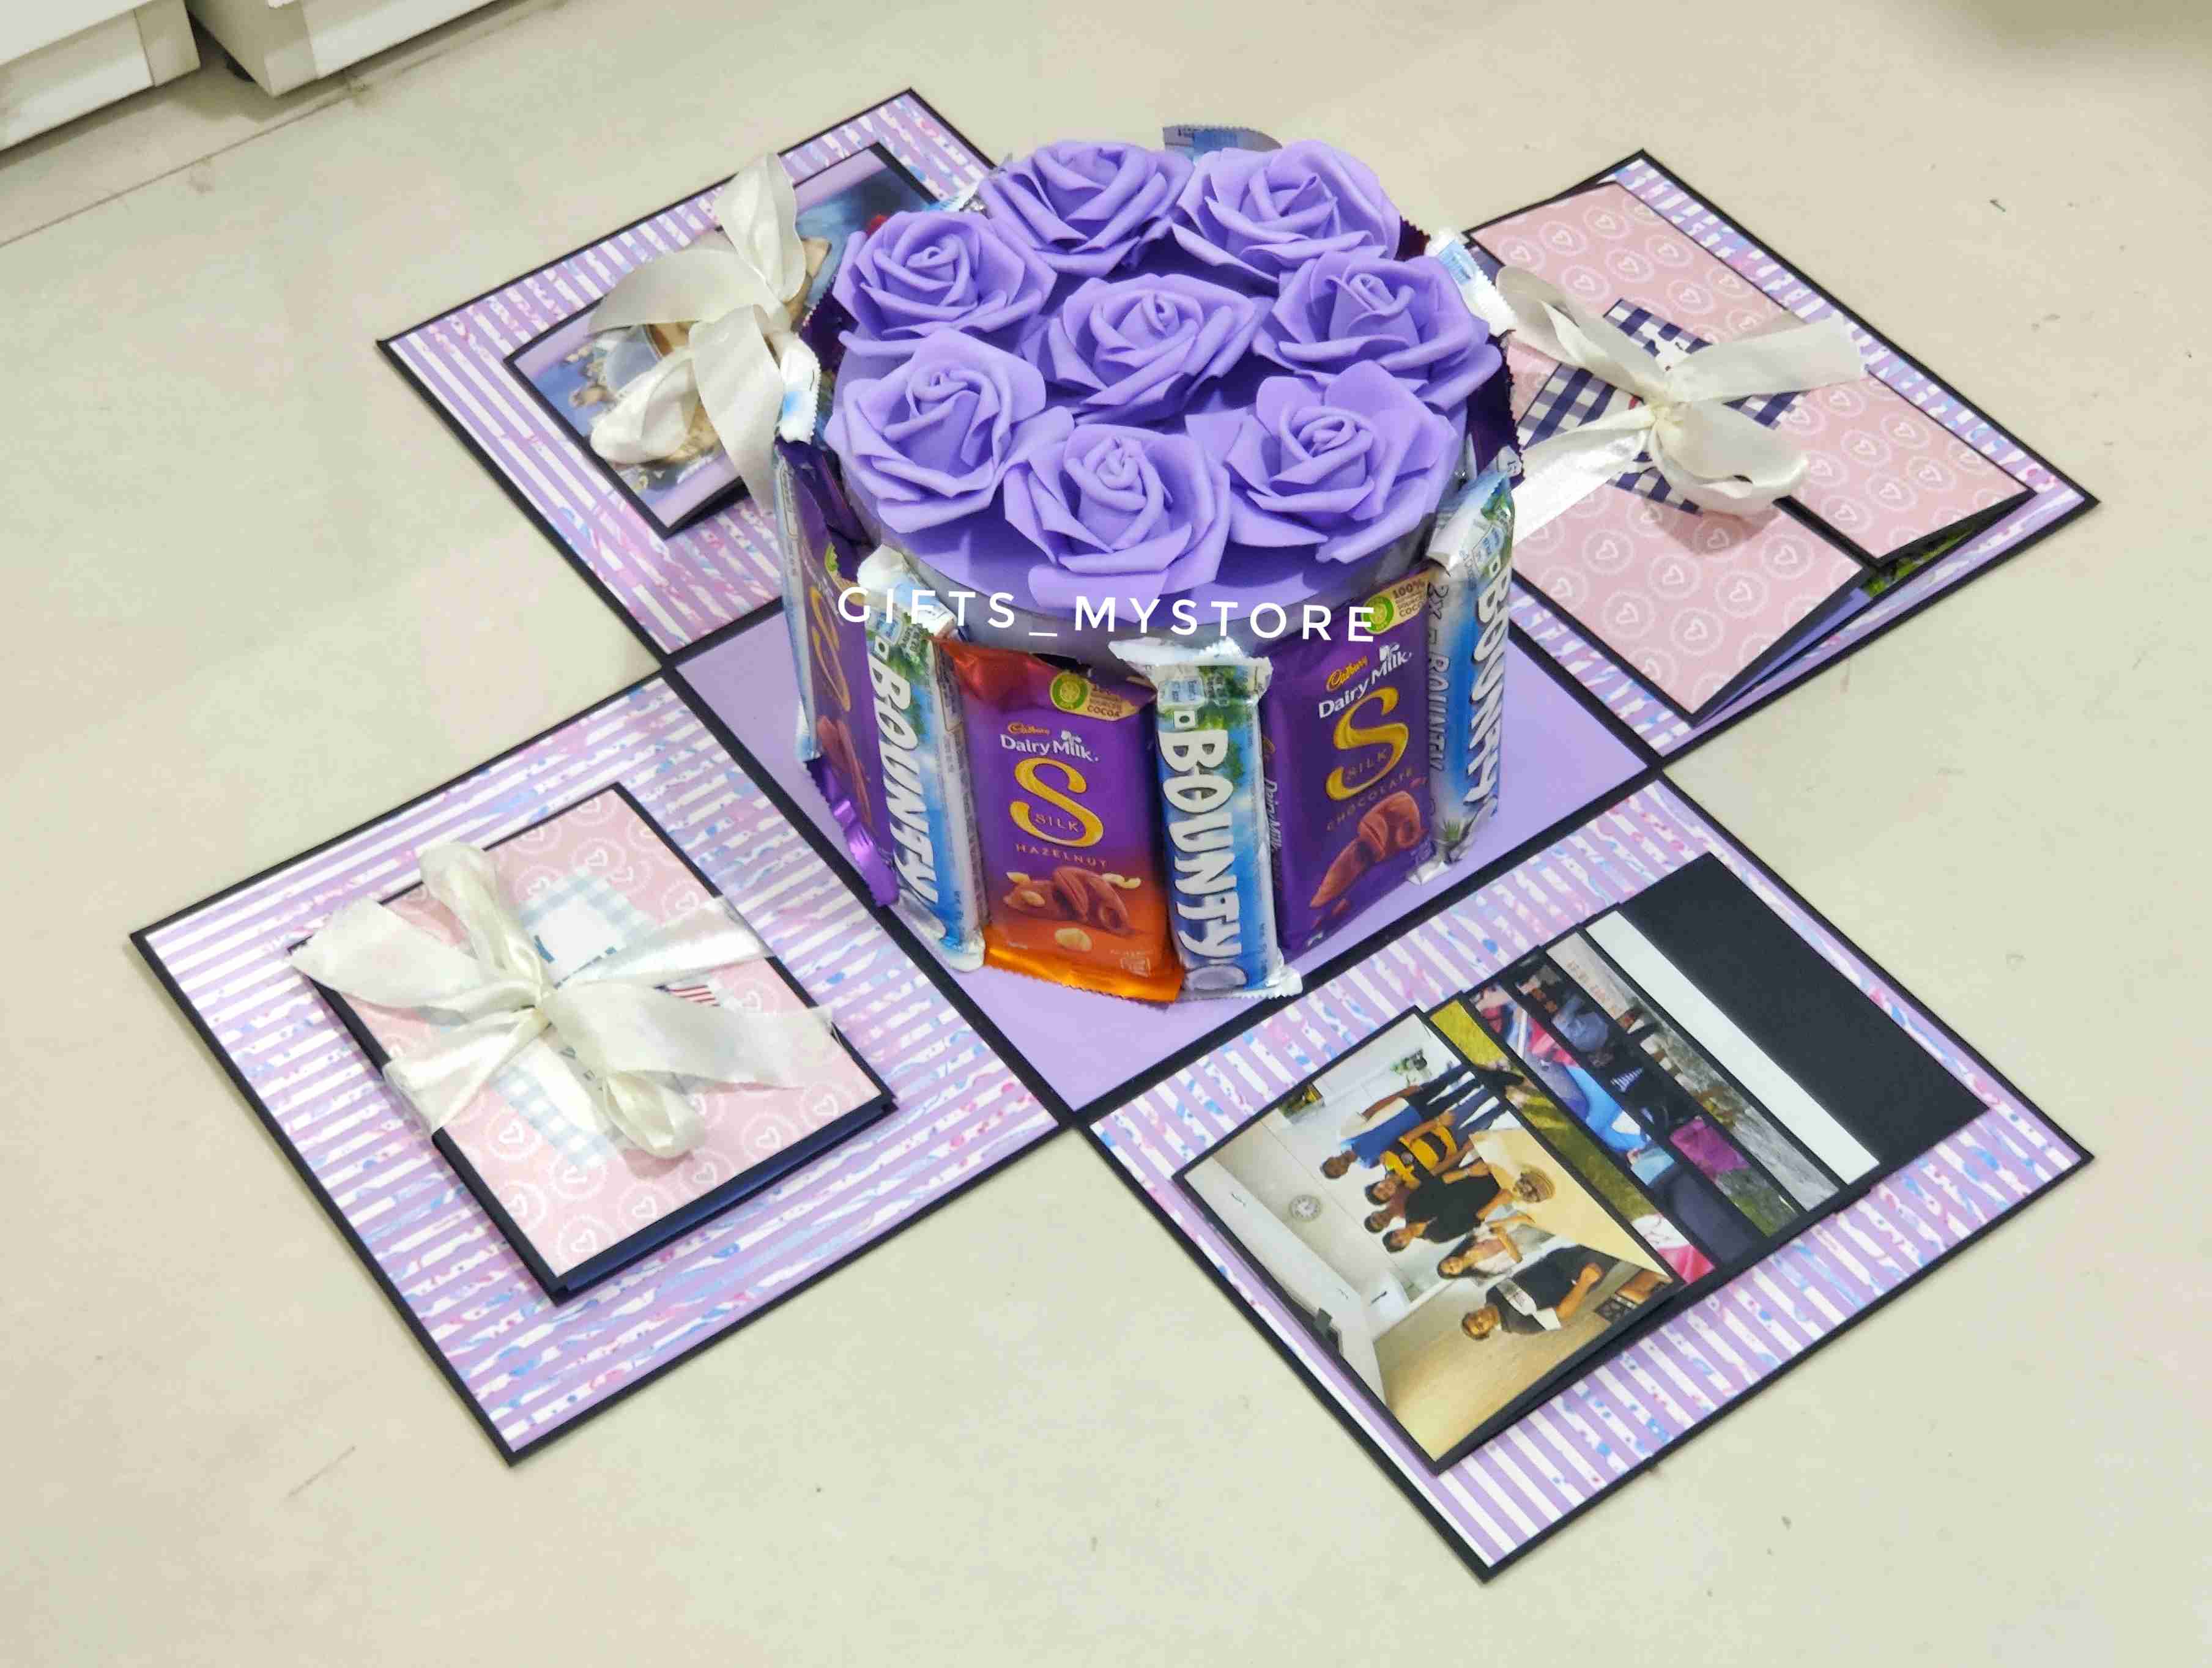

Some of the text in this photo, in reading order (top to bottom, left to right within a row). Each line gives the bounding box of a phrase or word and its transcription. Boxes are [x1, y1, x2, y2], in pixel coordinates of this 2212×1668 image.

[1086, 704, 1123, 717] COCOA
[1319, 648, 1409, 718] Dairy Milk
[1464, 564, 1512, 804] BOUNTY
[867, 653, 940, 903] BOUNTY
[1000, 734, 1095, 762] Dairy Milk
[1347, 748, 1387, 782] SILK
[1009, 757, 1104, 848] S
[1035, 813, 1080, 832] SILK
[1326, 766, 1412, 831] CHOCOLATE
[1015, 843, 1107, 867] HAZELNUT
[1157, 729, 1243, 958] BOUNTY
